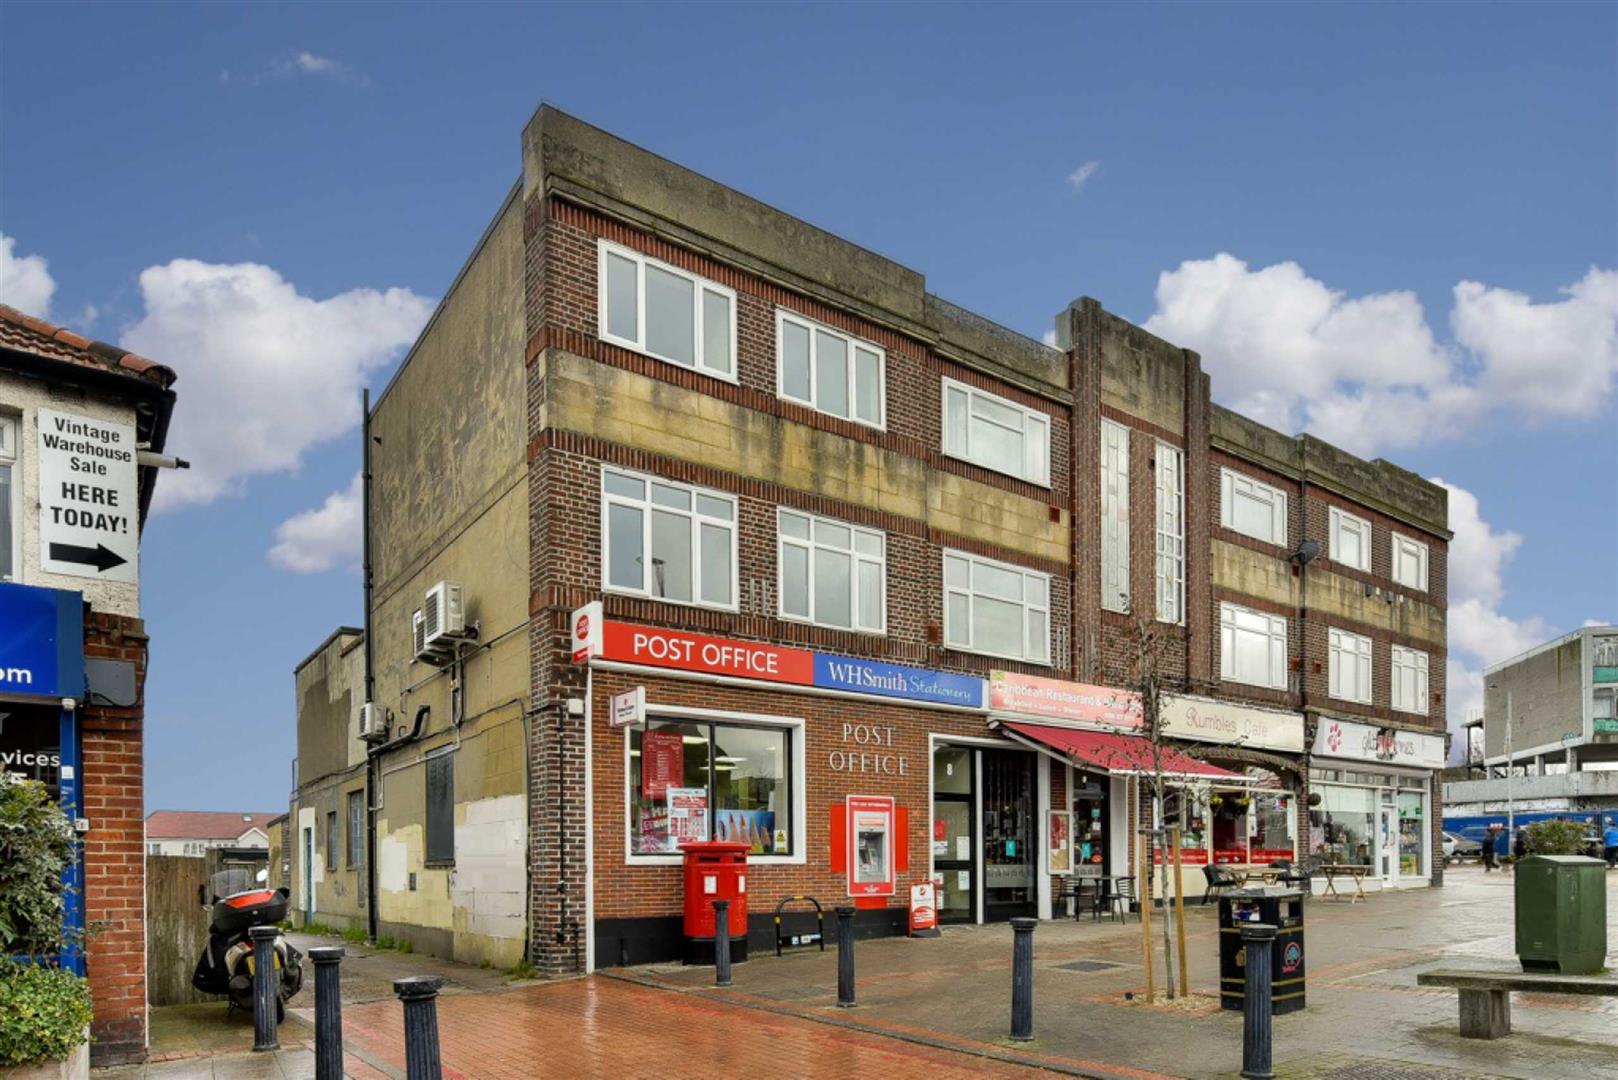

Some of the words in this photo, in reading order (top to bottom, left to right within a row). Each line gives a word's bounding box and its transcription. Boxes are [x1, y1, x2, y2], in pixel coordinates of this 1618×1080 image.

[54, 416, 120, 444] Vintage
[43, 432, 132, 462] Warehouse
[70, 456, 107, 476] Sale
[61, 481, 119, 507] HERE
[50, 506, 128, 534] TODAY!
[633, 633, 695, 662] POST
[702, 643, 779, 674] OFFICE
[828, 661, 908, 692] WHSmith
[910, 674, 971, 703] Stationery
[842, 722, 896, 747] POST
[829, 750, 910, 776] OFFICE
[946, 763, 953, 776] 8
